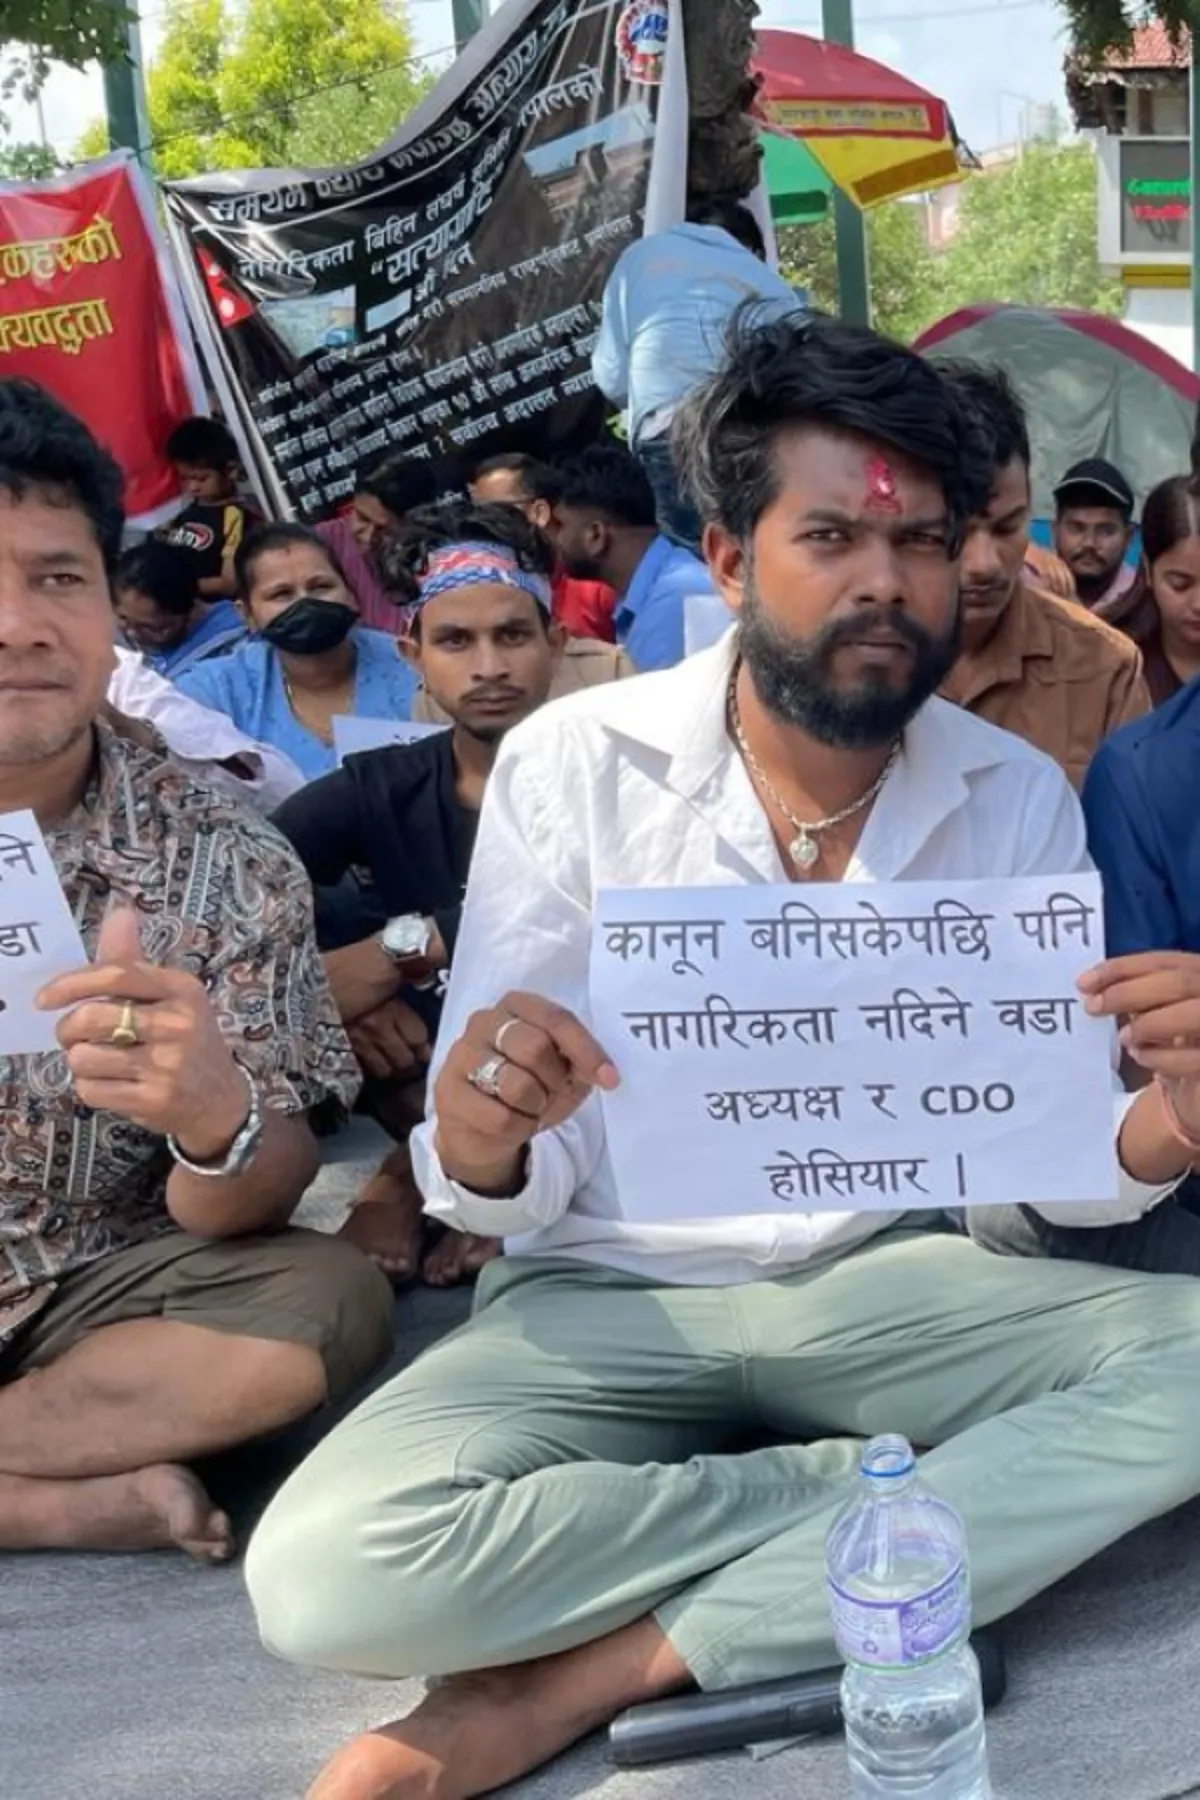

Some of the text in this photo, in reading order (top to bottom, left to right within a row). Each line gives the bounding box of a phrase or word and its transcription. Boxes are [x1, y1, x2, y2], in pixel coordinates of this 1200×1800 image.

[602, 891, 1094, 976] कानून बनिसकेपछि पनि
[621, 986, 1078, 1051] नागरिकता नदिने वडा
[703, 1082, 1015, 1125] अध्यक्ष र CDO
[762, 1147, 930, 1202] होसियार
